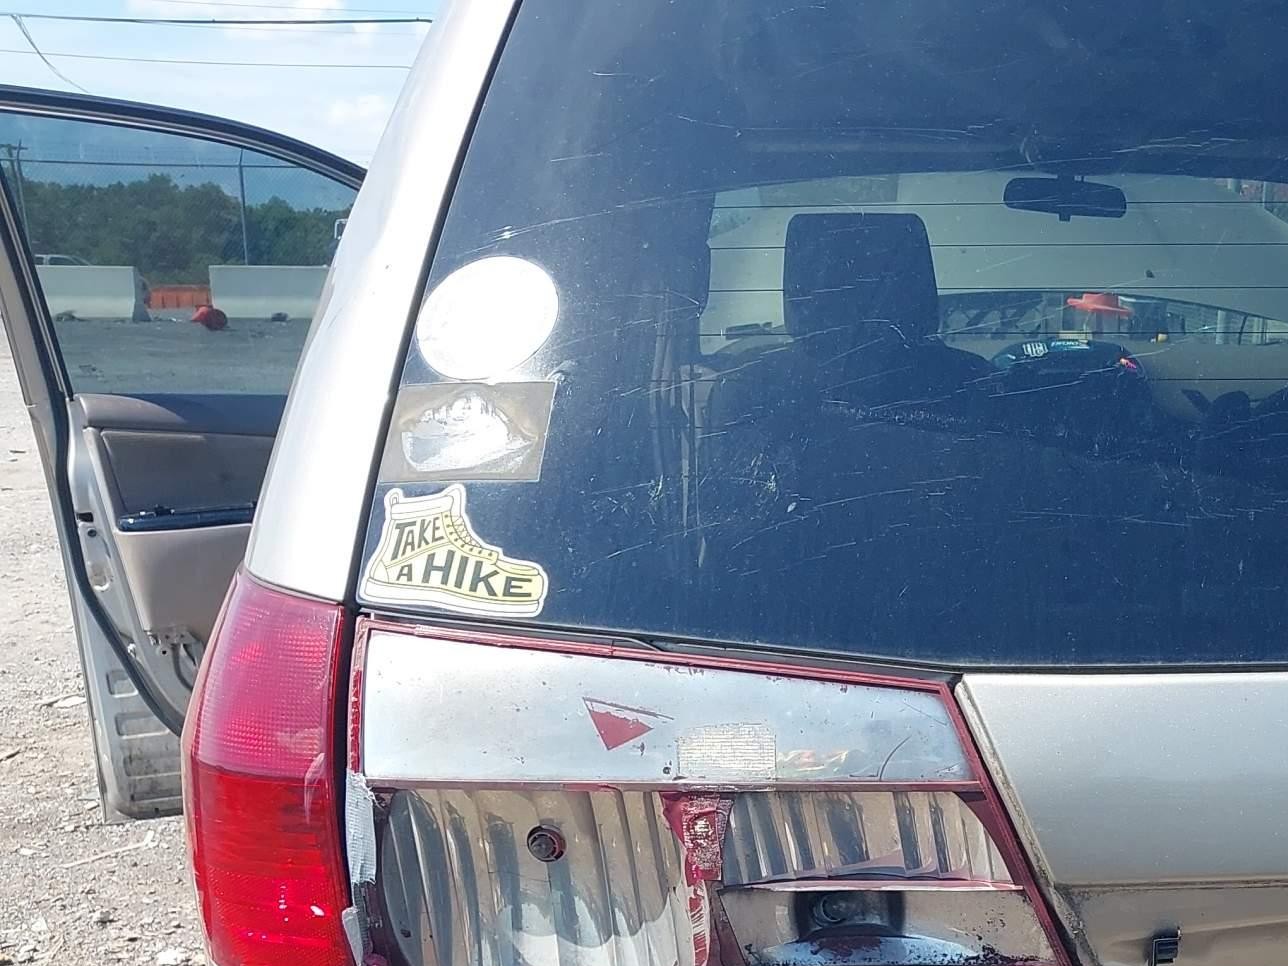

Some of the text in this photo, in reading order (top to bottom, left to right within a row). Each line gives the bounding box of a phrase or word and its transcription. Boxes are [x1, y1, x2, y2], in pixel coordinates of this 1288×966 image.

[390, 516, 445, 561] TAKE
[396, 549, 533, 598] A HIKE
